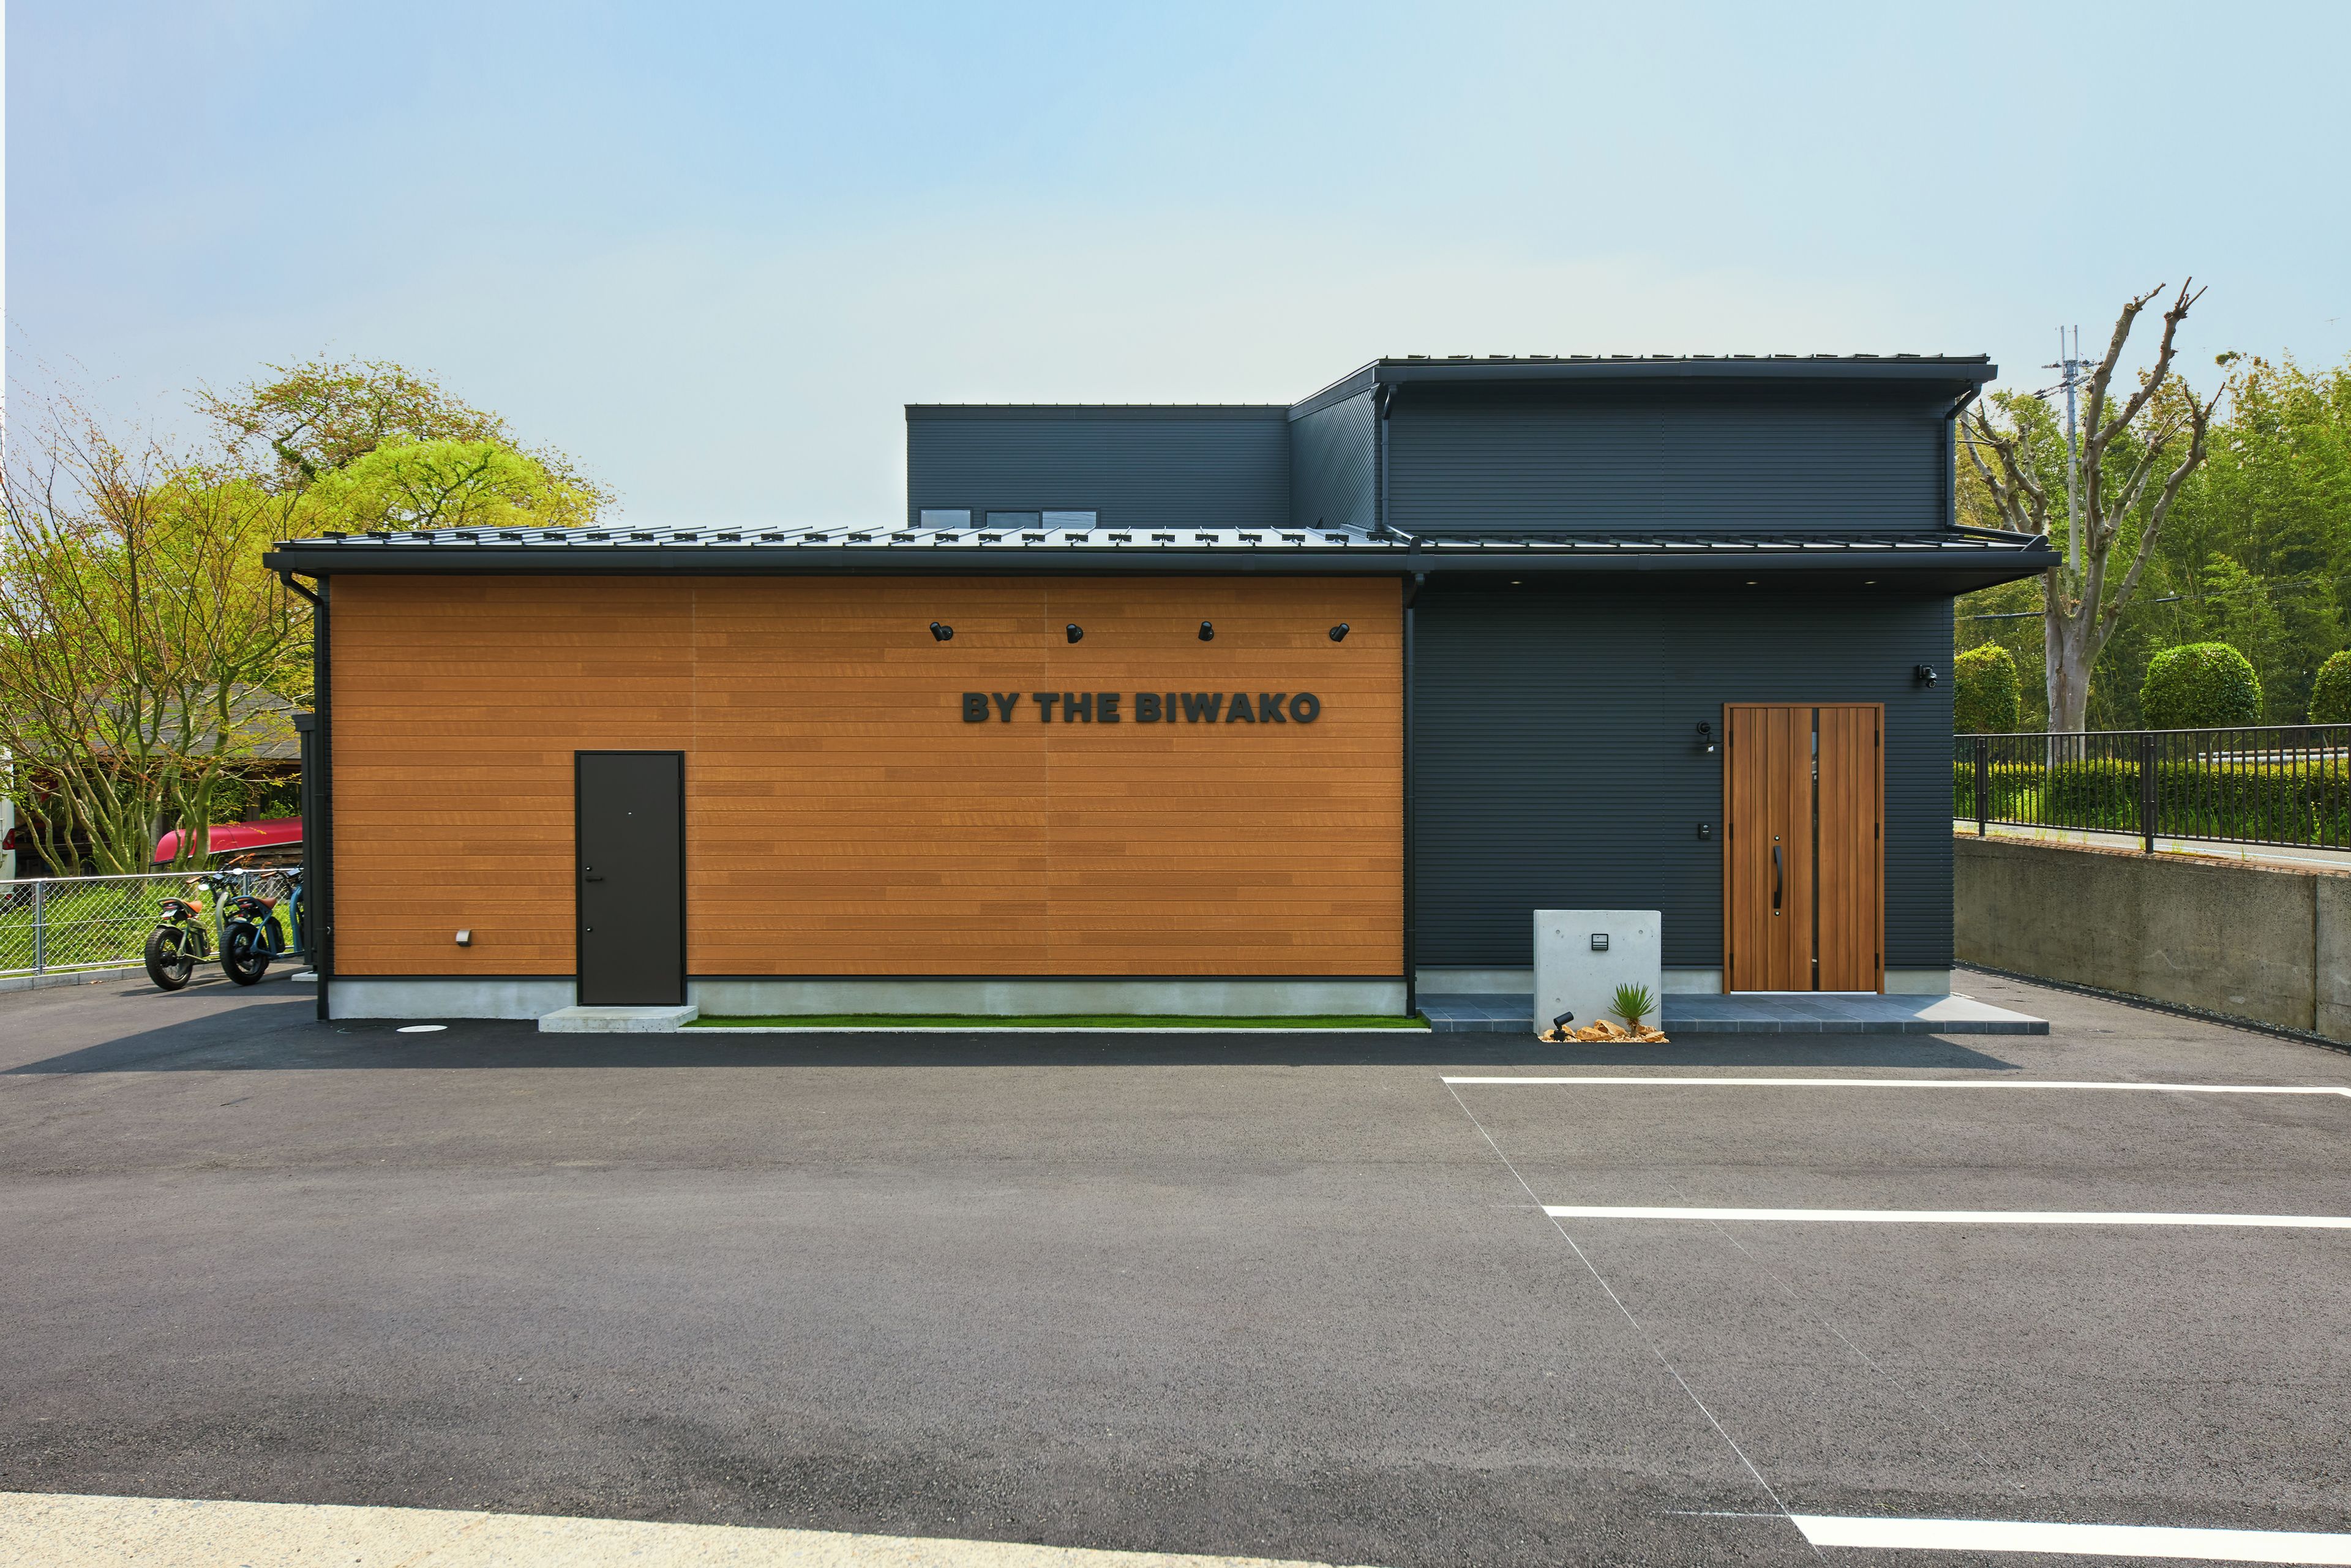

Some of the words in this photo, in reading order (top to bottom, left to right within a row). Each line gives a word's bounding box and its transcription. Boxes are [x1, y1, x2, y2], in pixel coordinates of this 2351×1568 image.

[963, 692, 1020, 722] BY
[1033, 692, 1120, 722] THE
[1135, 692, 1321, 722] BIWAKO
